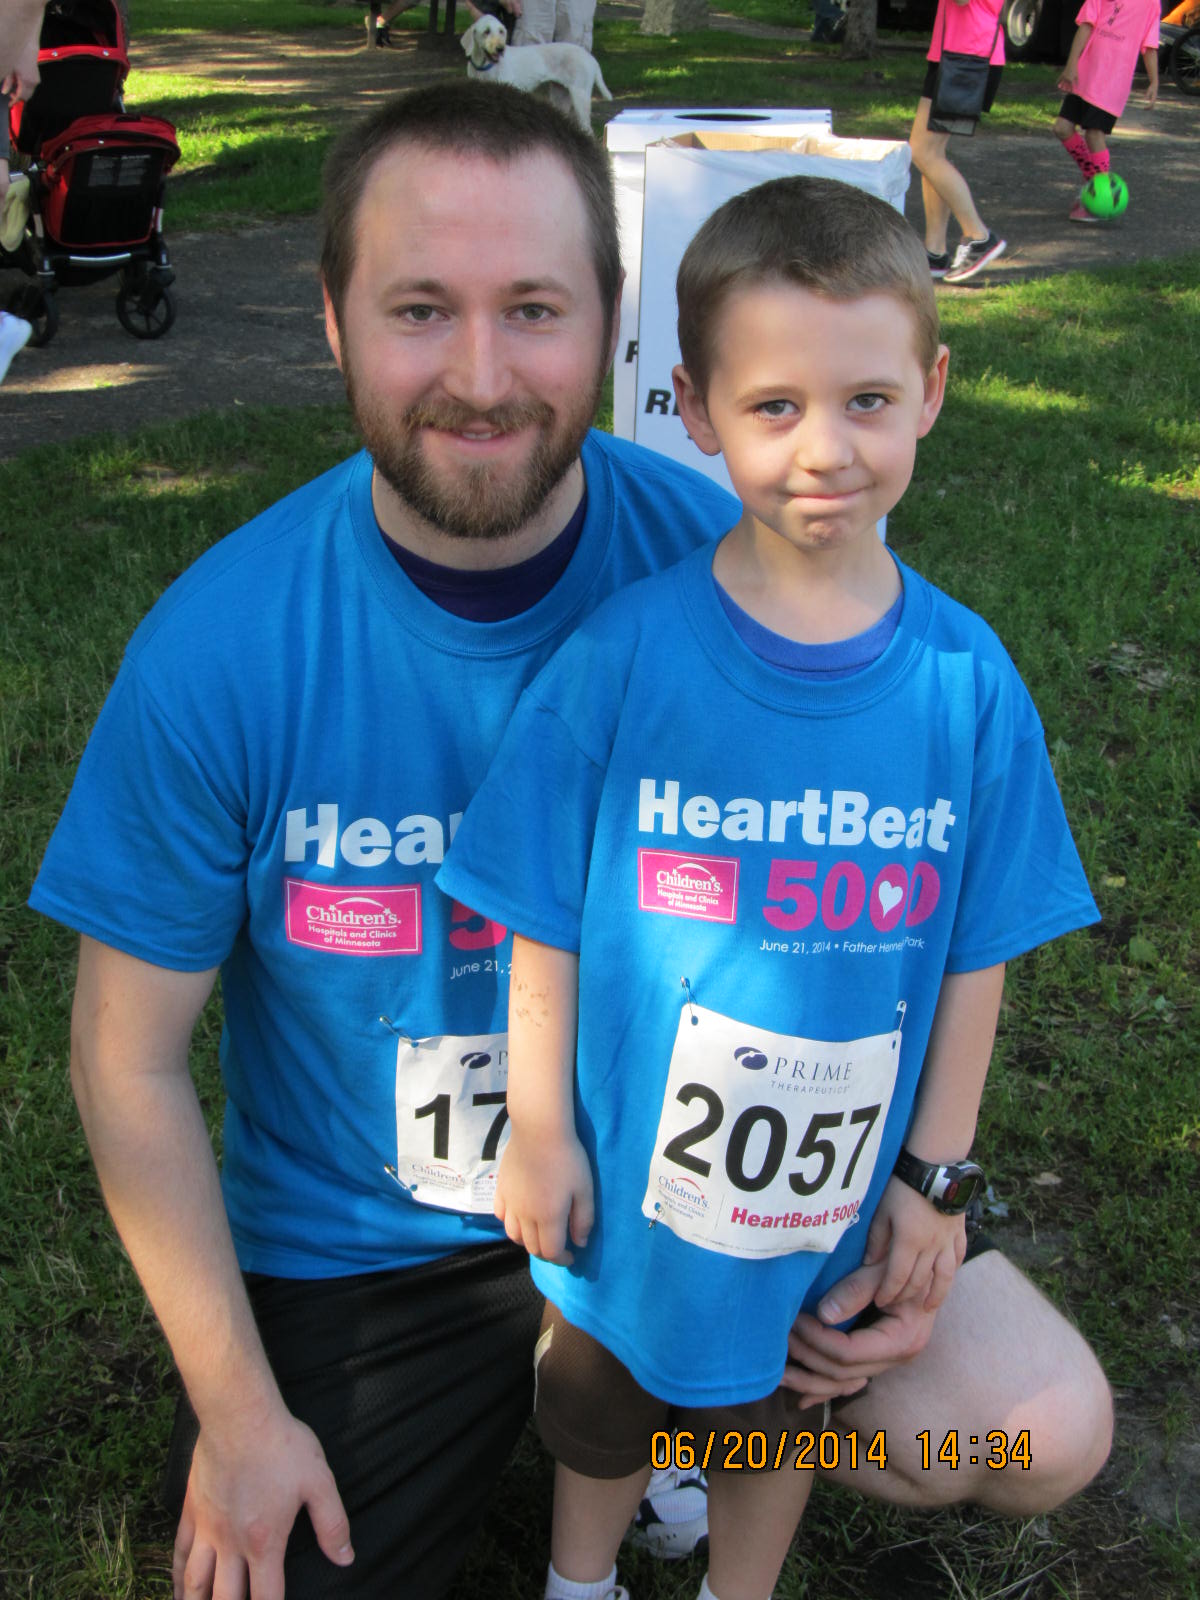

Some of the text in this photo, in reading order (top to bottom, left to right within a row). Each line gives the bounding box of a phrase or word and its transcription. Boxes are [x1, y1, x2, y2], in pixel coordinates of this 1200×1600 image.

[638, 778, 956, 853] HeartBeat
[762, 859, 941, 932] 5000
[308, 925, 397, 939] Hospitals and Clinics
[334, 937, 381, 947] Minnesota
[759, 939, 789, 952] June
[792, 942, 809, 955] 21,
[812, 941, 831, 954] 2014
[843, 941, 876, 953] Father
[450, 962, 480, 980] June
[774, 1056, 853, 1081] PRIME
[663, 1082, 882, 1197] 2057
[731, 1199, 860, 1229] HeartBeat 5000
